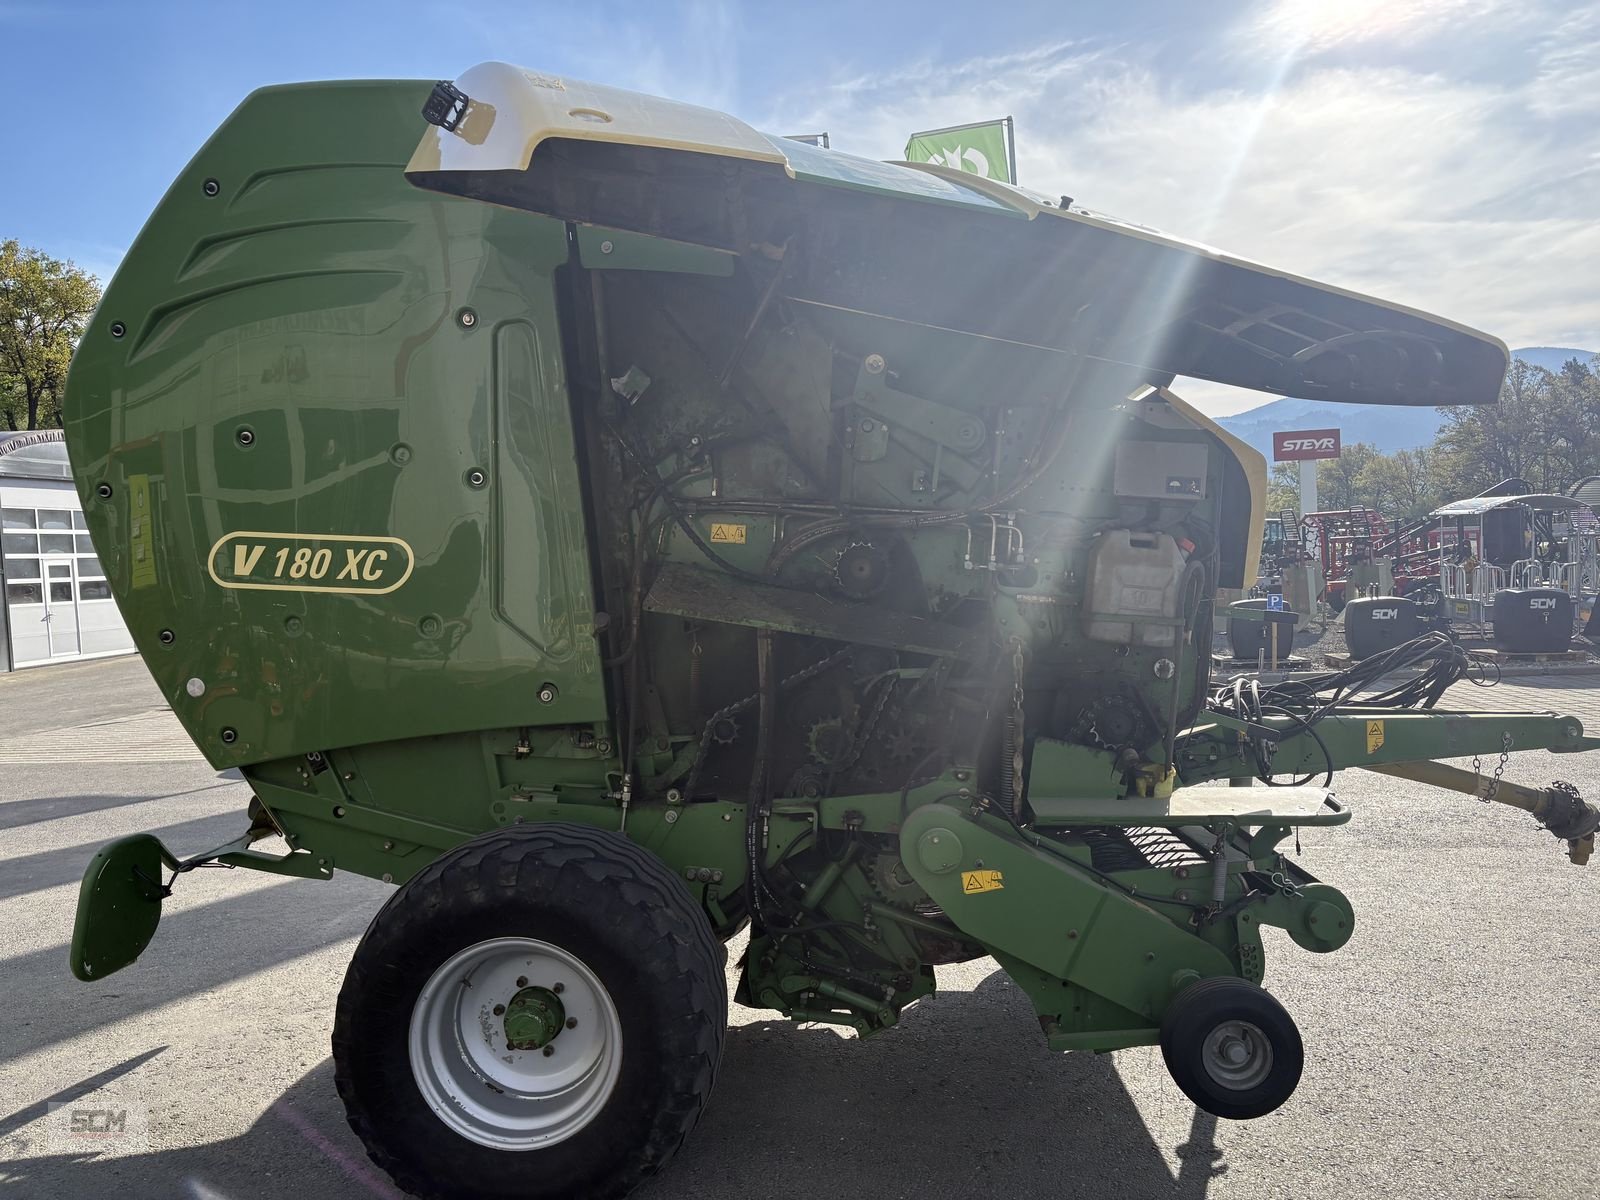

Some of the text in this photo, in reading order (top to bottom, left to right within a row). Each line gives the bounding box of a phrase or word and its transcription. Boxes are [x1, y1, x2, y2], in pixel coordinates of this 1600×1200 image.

[1281, 438, 1335, 452] STEYR
[234, 544, 388, 581] V 180 XC
[1271, 596, 1279, 606] P
[1529, 598, 1557, 609] SCM
[1371, 608, 1398, 620] SCM
